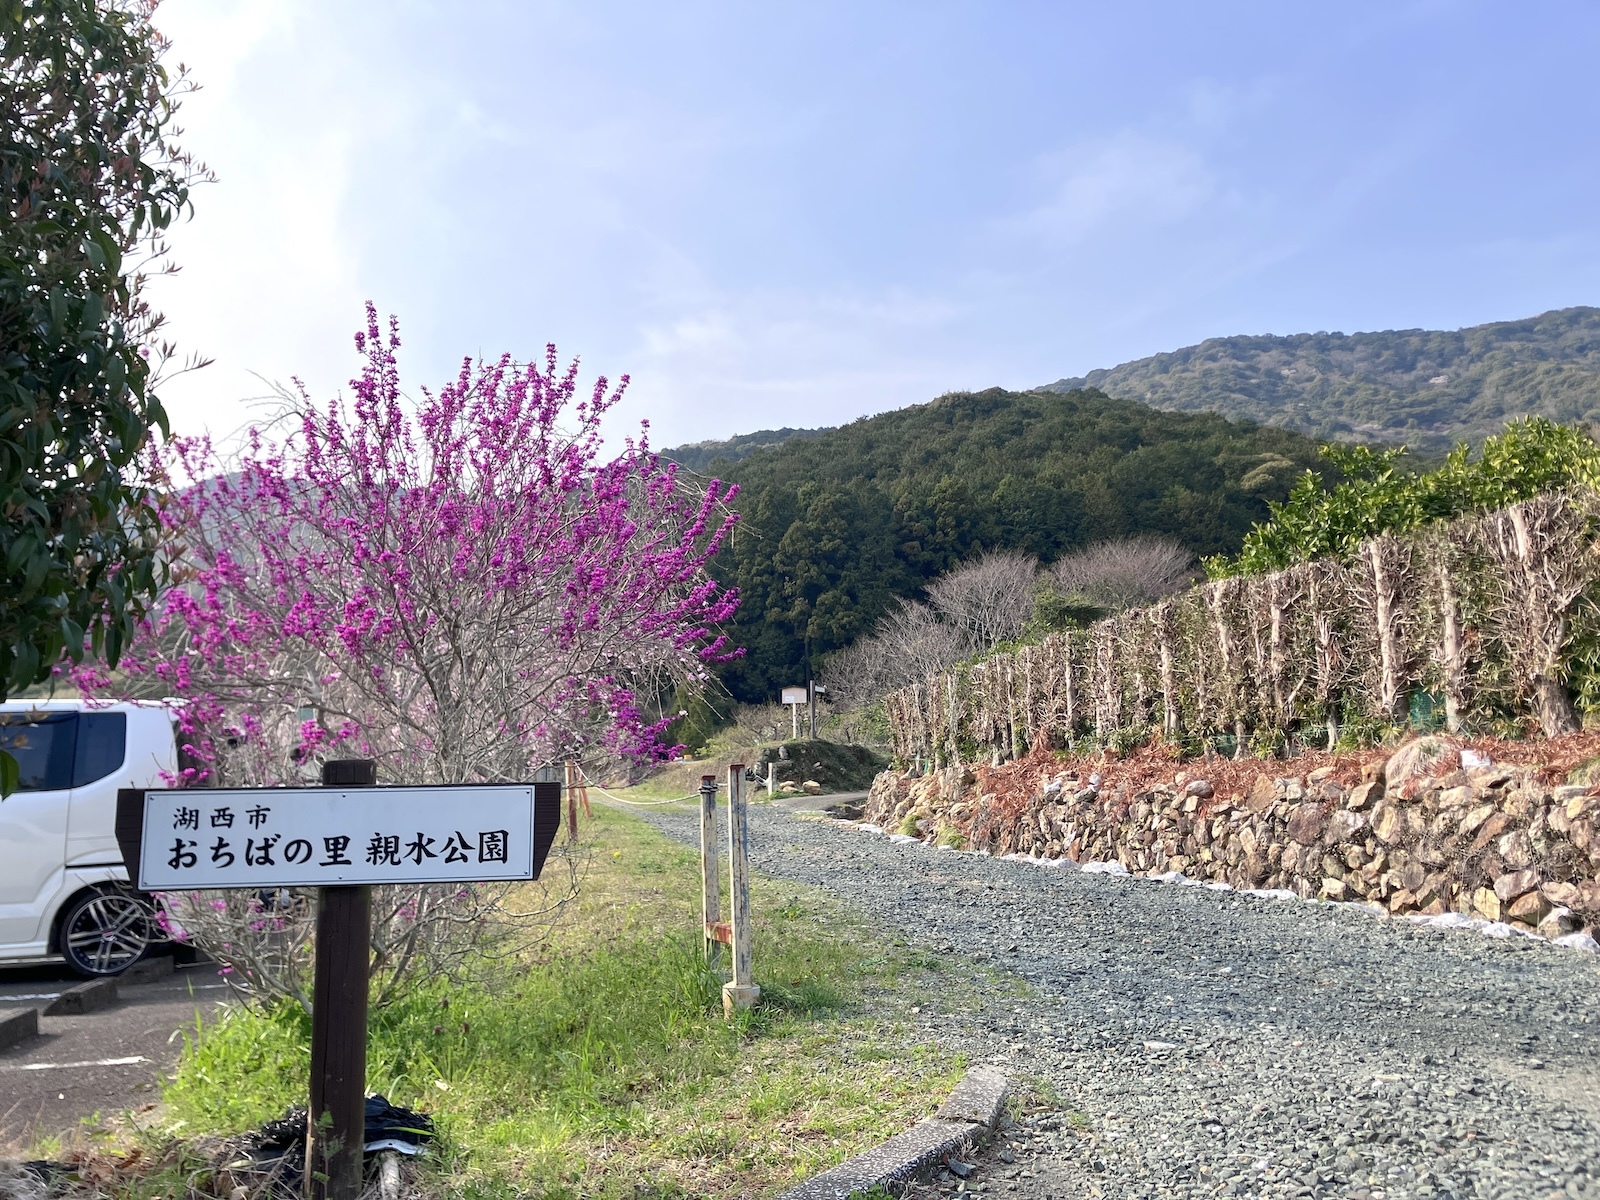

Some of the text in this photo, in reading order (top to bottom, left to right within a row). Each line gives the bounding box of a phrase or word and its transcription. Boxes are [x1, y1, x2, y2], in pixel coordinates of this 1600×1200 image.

[172, 804, 271, 831] 湖西市
[167, 829, 510, 869] おちばの里 親水公園
